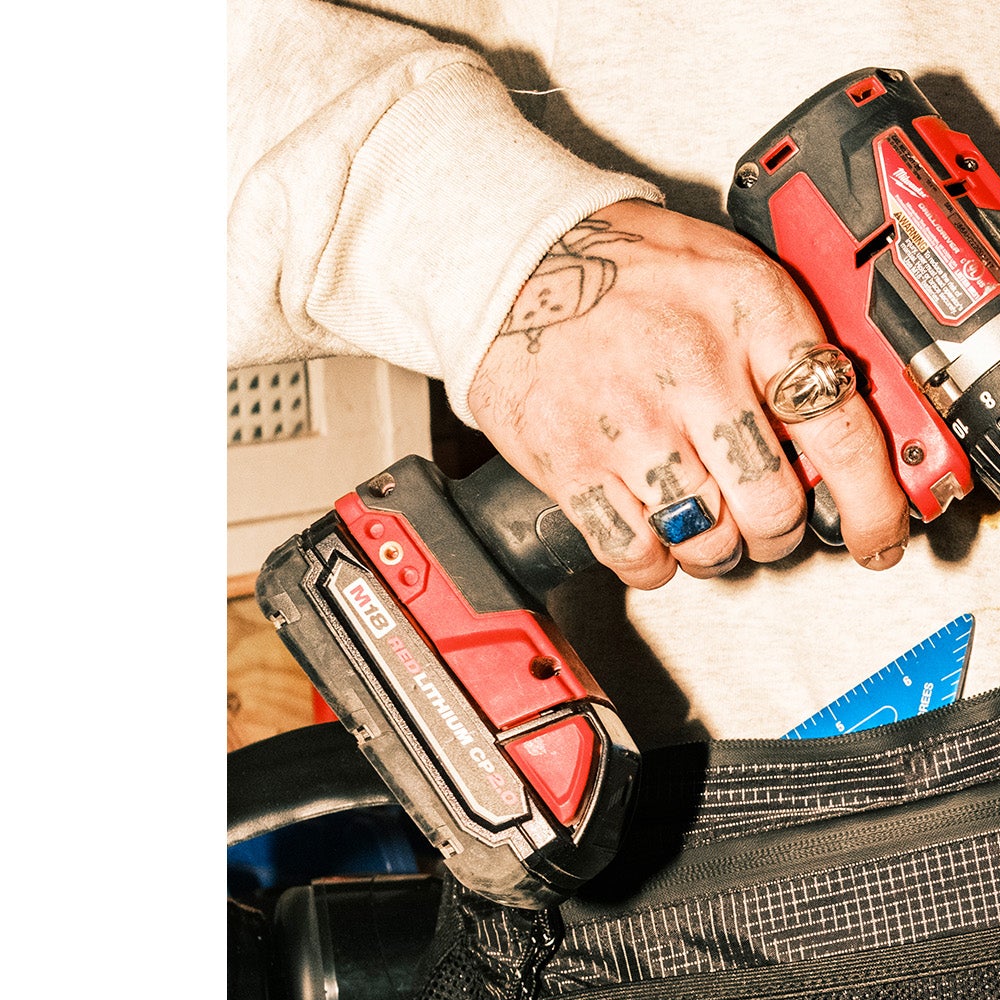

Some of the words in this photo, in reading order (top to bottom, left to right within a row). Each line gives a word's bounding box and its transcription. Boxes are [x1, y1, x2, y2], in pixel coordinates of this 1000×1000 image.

[892, 167, 928, 198] Milwaukee
[898, 215, 929, 251] WARNING
[917, 202, 960, 254] DRILL/DRIVER
[979, 391, 996, 409] 8
[952, 418, 969, 439] 10
[350, 584, 390, 632] M18
[902, 675, 913, 687] 6
[917, 682, 935, 716] REES
[387, 636, 474, 746] REDLITHIUM
[469, 747, 518, 806] CP2.0
[835, 720, 846, 732] 5
